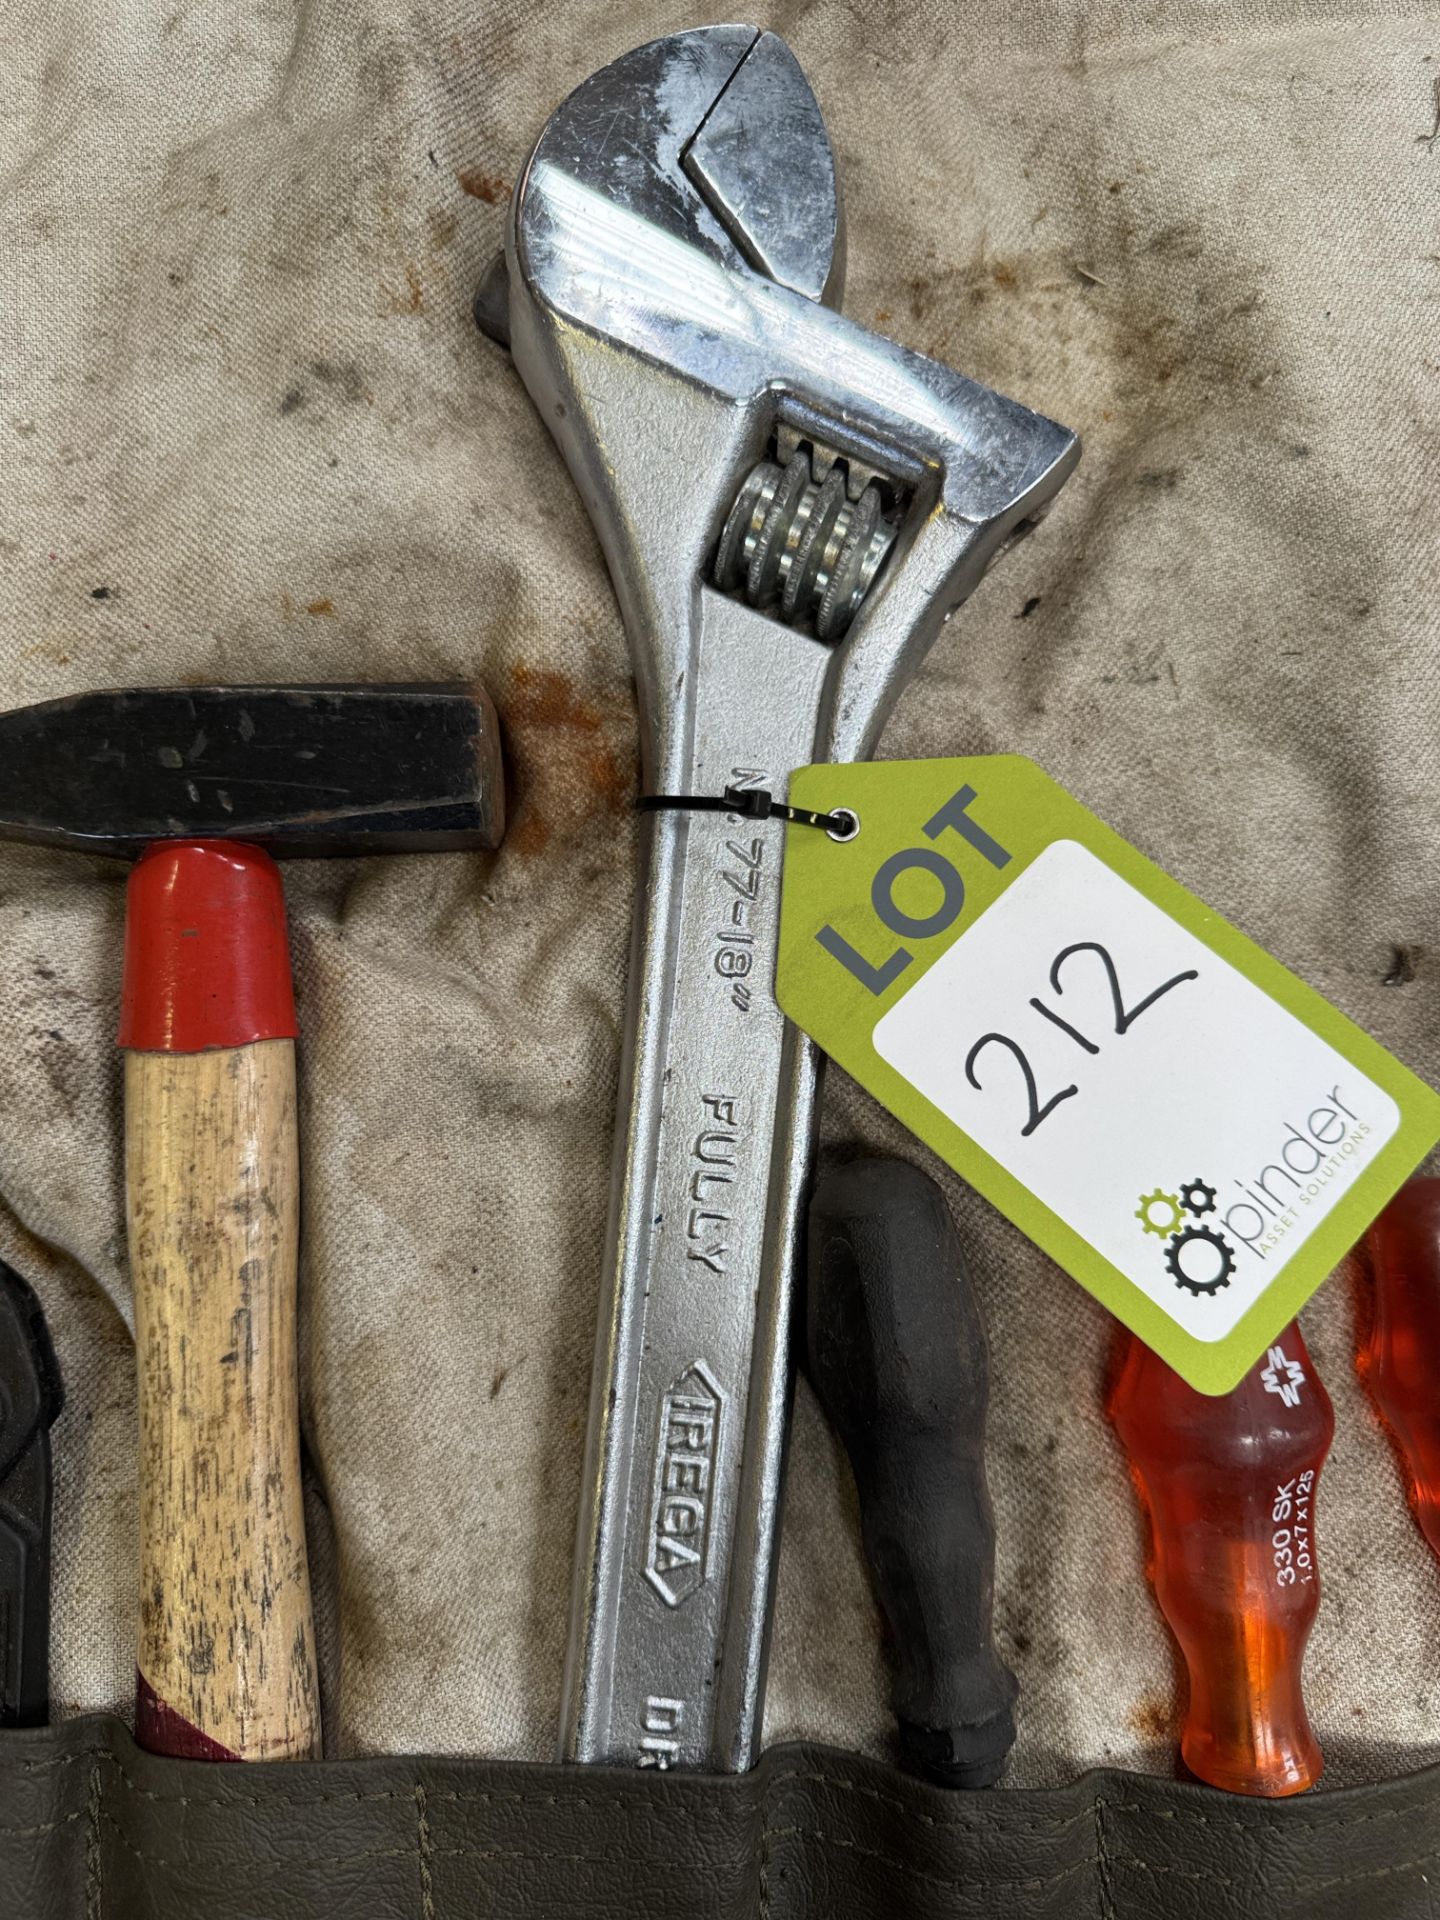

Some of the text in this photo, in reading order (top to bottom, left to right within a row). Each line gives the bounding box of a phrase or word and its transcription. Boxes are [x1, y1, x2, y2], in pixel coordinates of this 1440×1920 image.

[813, 783, 1013, 997] LOT
[965, 942, 1199, 1137] 212
[687, 1093, 739, 1274] FULLY
[1219, 1084, 1358, 1260] pinder
[1259, 1122, 1372, 1254] ASSET SOLUTIONS
[656, 1396, 715, 1573] IREGA
[1272, 1478, 1296, 1588] 330 SK
